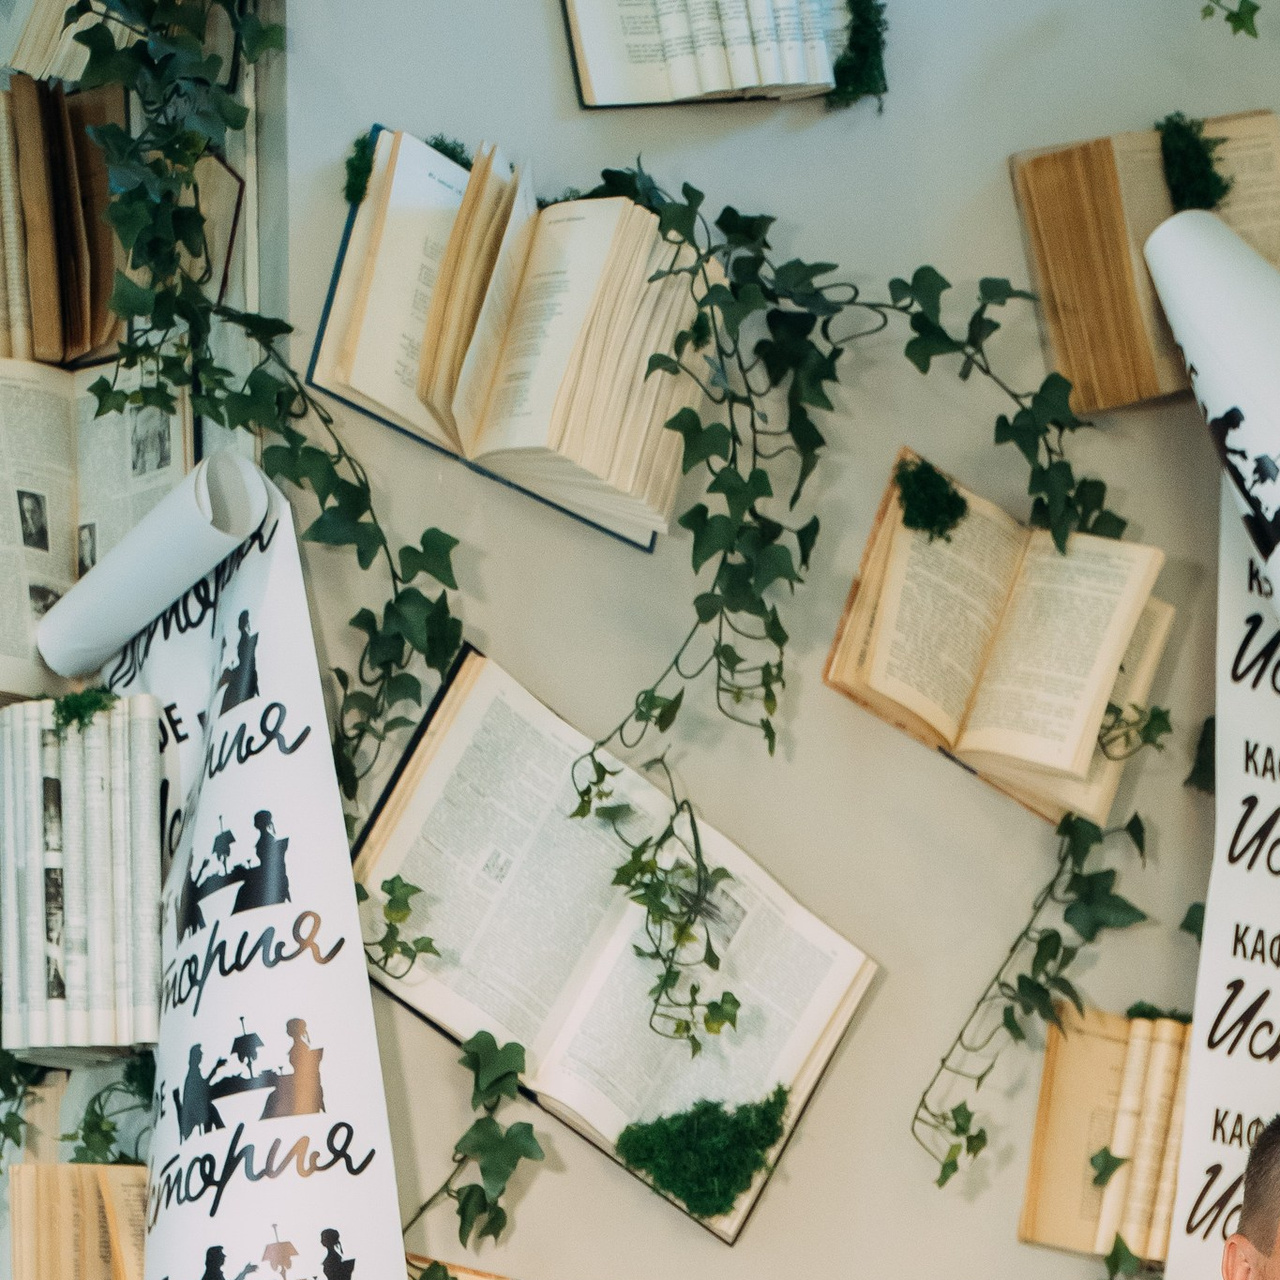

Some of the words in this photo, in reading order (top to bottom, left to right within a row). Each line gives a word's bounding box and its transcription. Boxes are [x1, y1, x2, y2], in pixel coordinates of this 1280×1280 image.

[163, 910, 345, 1018] тория
[147, 1121, 376, 1234] тория
[1212, 1107, 1265, 1148] КАФ
